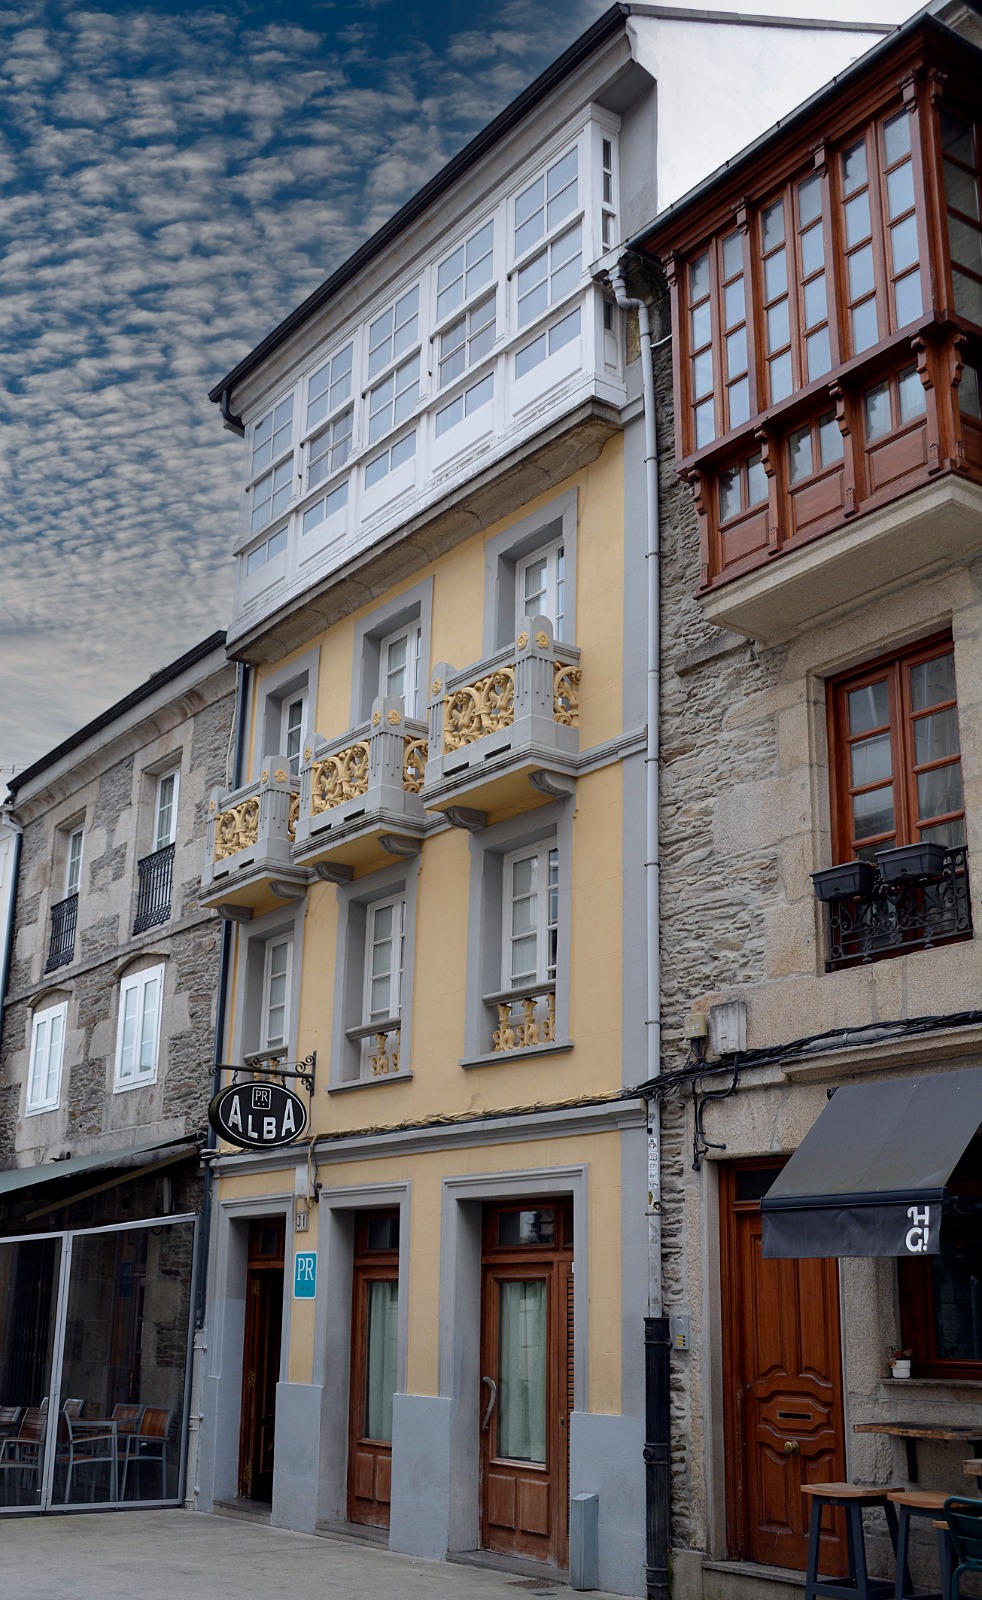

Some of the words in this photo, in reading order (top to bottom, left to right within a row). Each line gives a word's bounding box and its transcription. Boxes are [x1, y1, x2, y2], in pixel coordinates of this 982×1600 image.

[255, 1090, 268, 1102] PR
[228, 1095, 296, 1139] ALBA
[296, 1257, 314, 1281] PR
